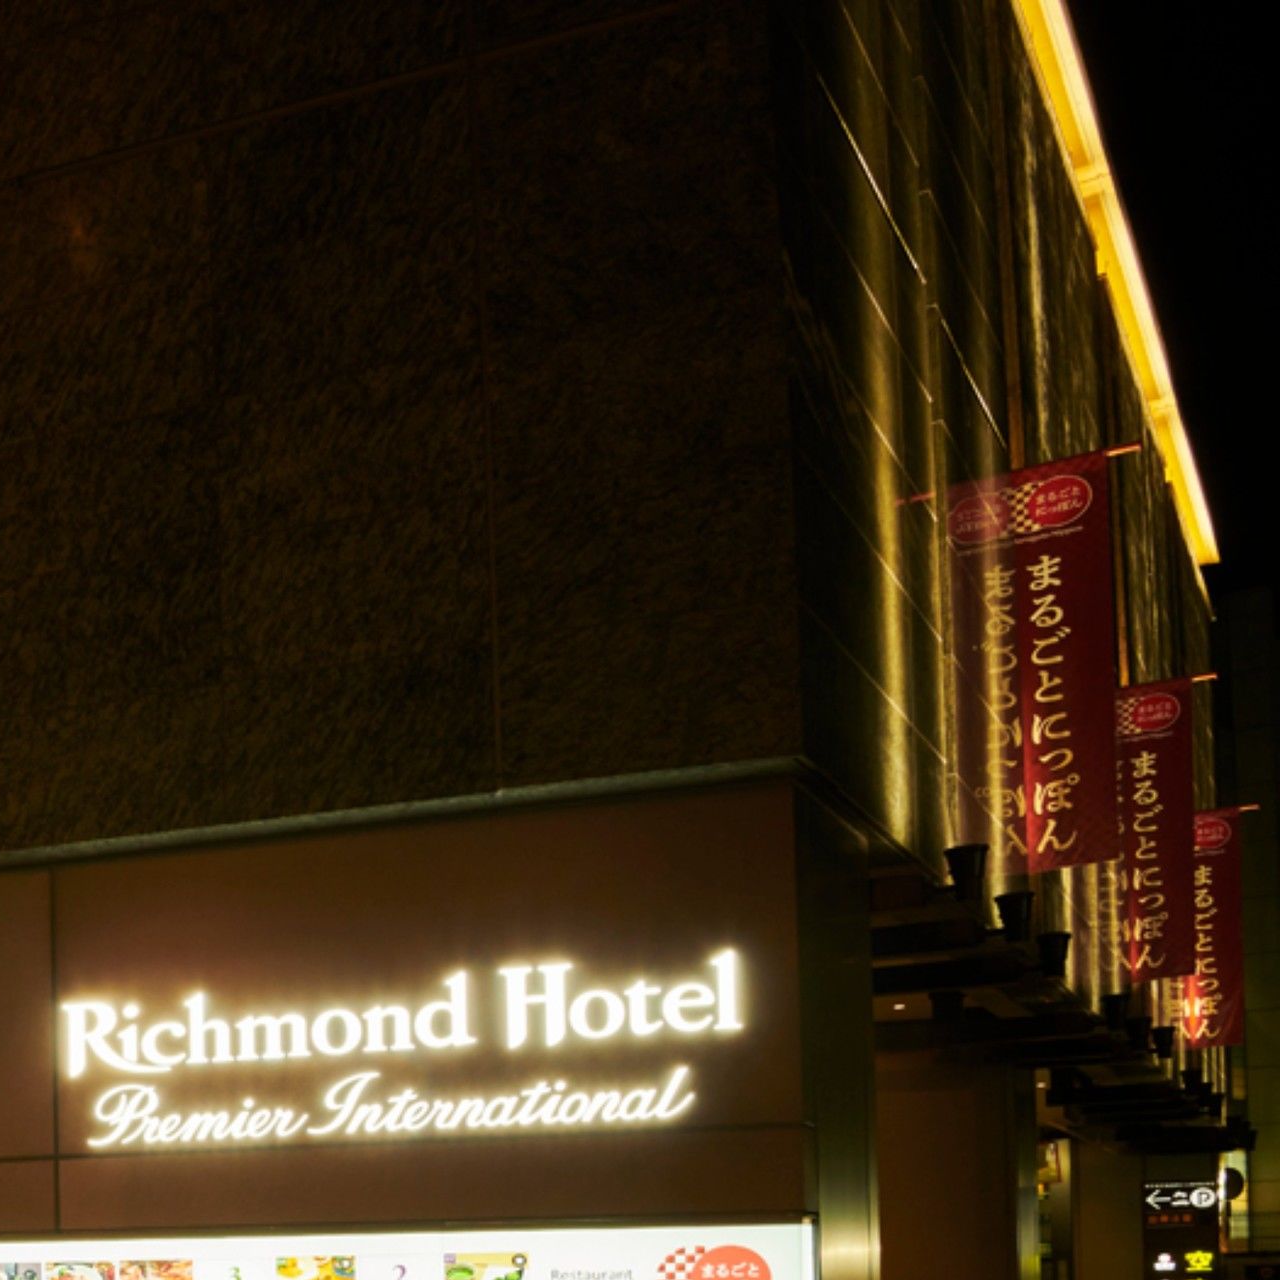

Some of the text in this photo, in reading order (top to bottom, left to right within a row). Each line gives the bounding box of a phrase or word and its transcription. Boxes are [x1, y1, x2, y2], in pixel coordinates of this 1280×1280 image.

[1026, 555, 1081, 854] まるごとにっぽん
[1130, 750, 1168, 970] まるごとにっぽん
[60, 948, 745, 1079] Richmond Hotel
[86, 1065, 696, 1149] Premier International
[701, 1262, 760, 1279] まるごと
